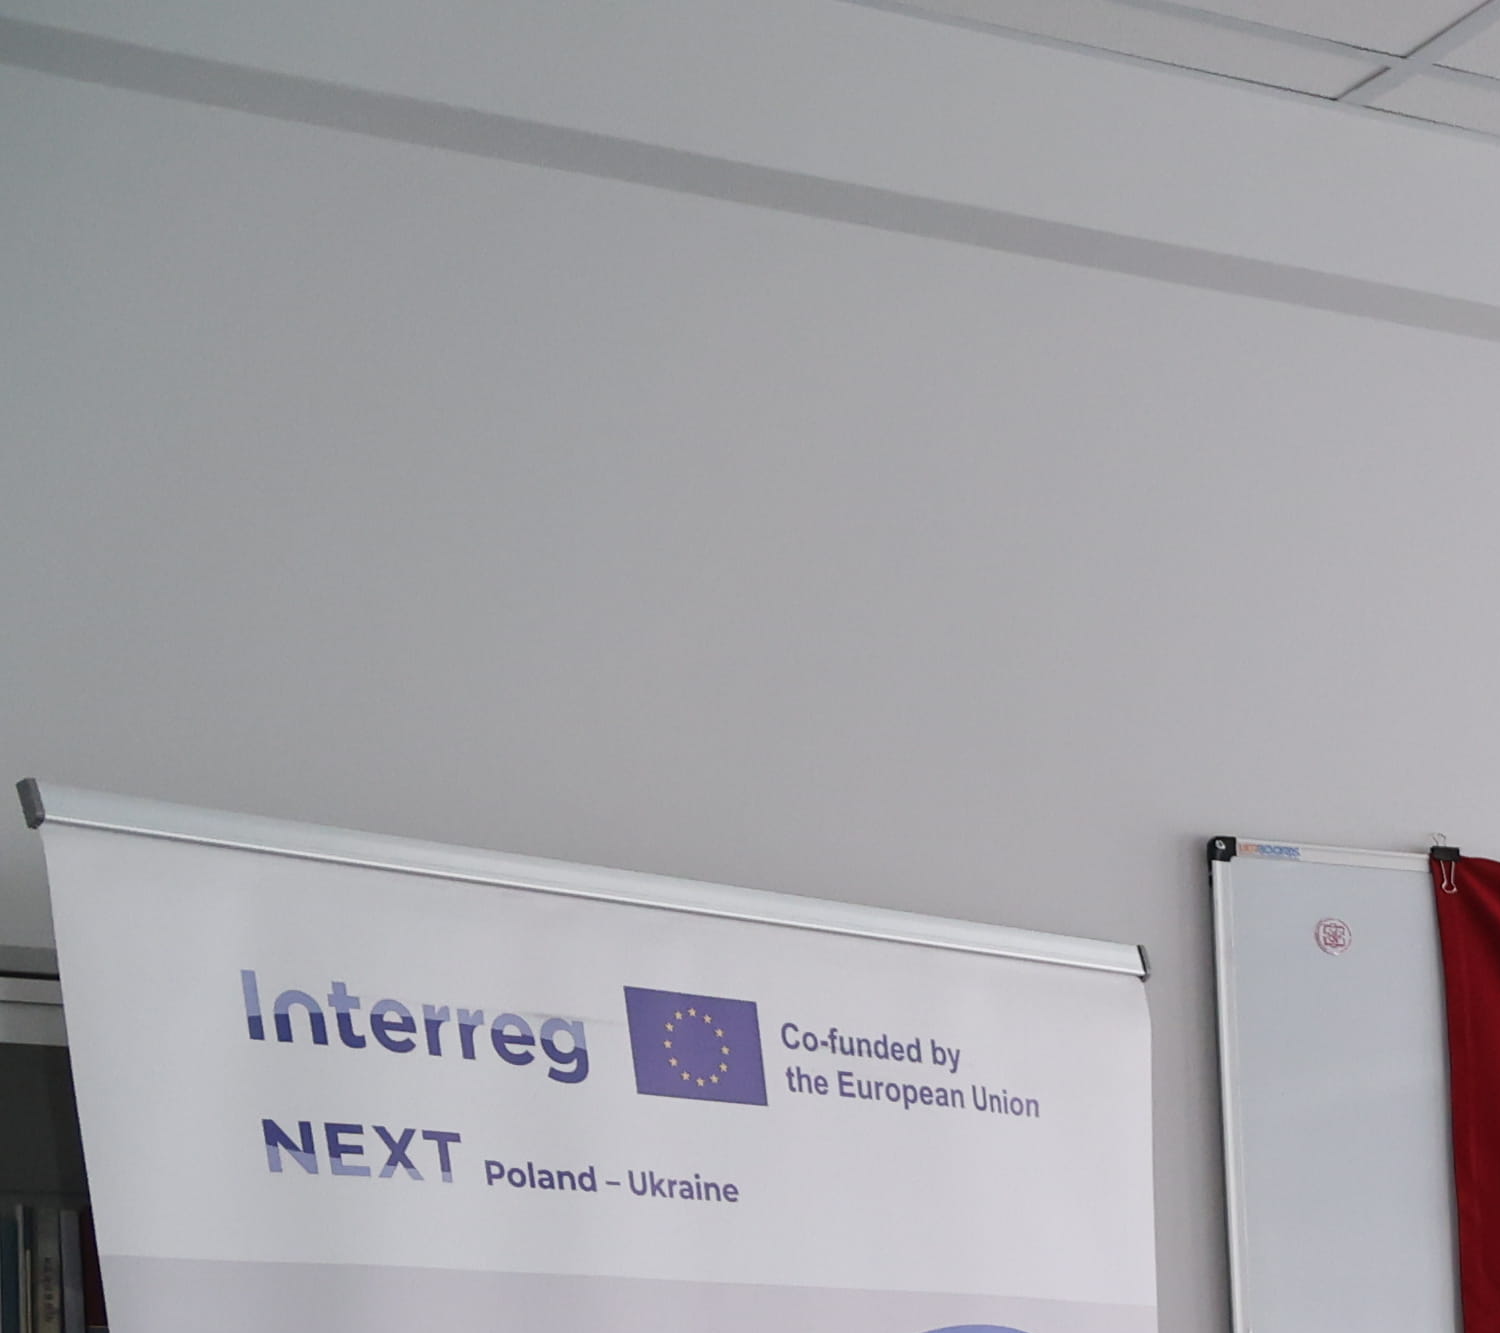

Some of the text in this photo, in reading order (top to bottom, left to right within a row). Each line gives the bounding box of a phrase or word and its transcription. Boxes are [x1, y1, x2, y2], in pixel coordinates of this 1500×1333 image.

[239, 969, 590, 1083] Interreg
[780, 1023, 962, 1073] Co-funded by
[786, 1066, 1040, 1119] the European Union
[262, 1118, 461, 1184] NEXT
[485, 1159, 598, 1194] Poland
[627, 1169, 740, 1204] Ukraine
